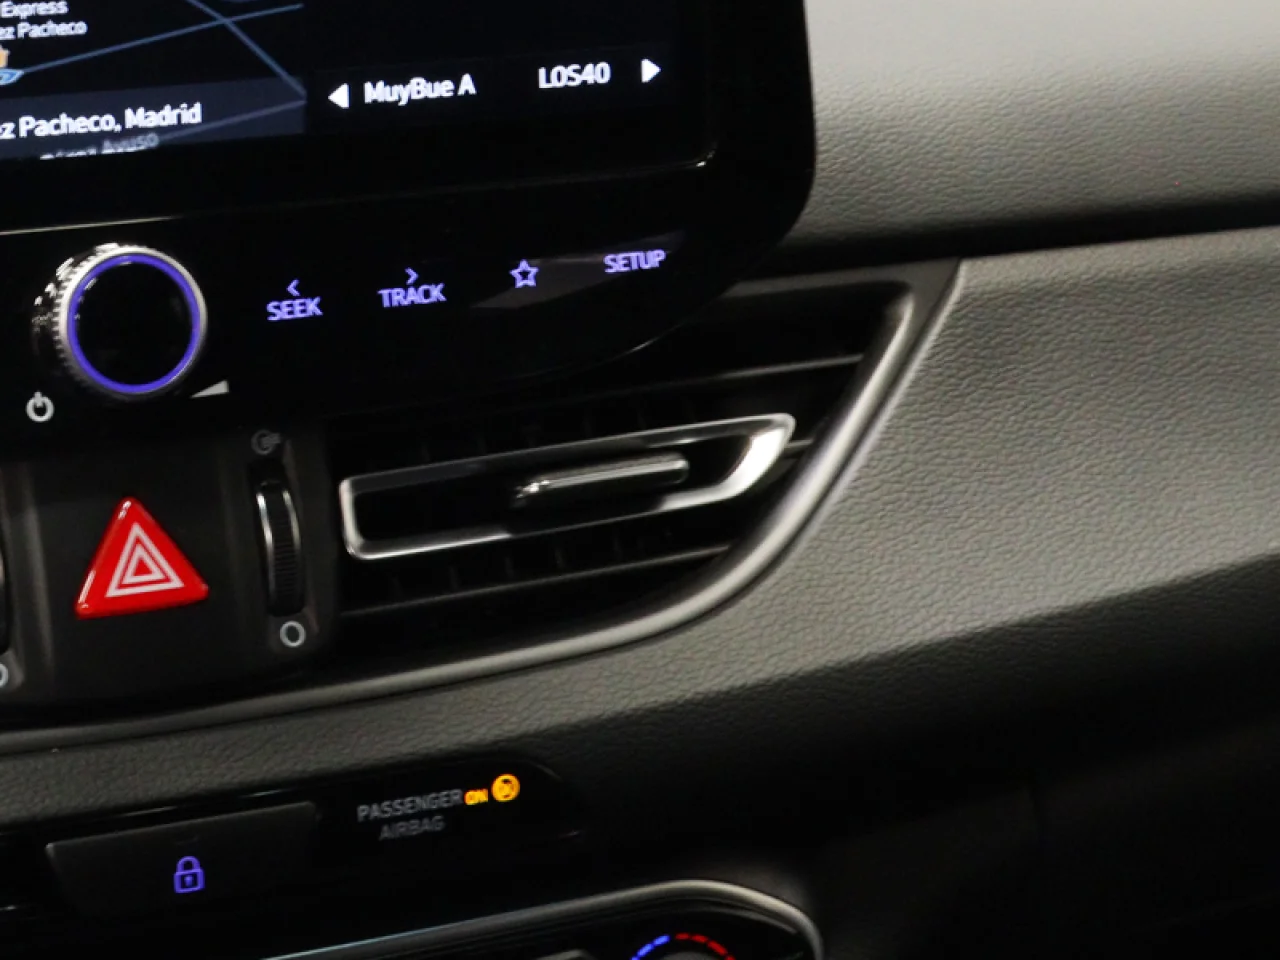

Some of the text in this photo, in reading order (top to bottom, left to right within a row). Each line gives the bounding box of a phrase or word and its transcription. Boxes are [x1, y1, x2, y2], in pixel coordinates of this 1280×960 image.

[0, 0, 68, 19] Express
[18, 20, 88, 39] Pacheco
[364, 74, 477, 105] MuyBue A
[19, 111, 122, 139] Pacheco,
[125, 102, 202, 128] Madrid
[604, 249, 666, 274] SETUP
[378, 283, 446, 308] TRACK
[266, 297, 322, 321] SEEK
[357, 789, 463, 822] PASSENGER
[379, 816, 445, 841] AIRBAG
